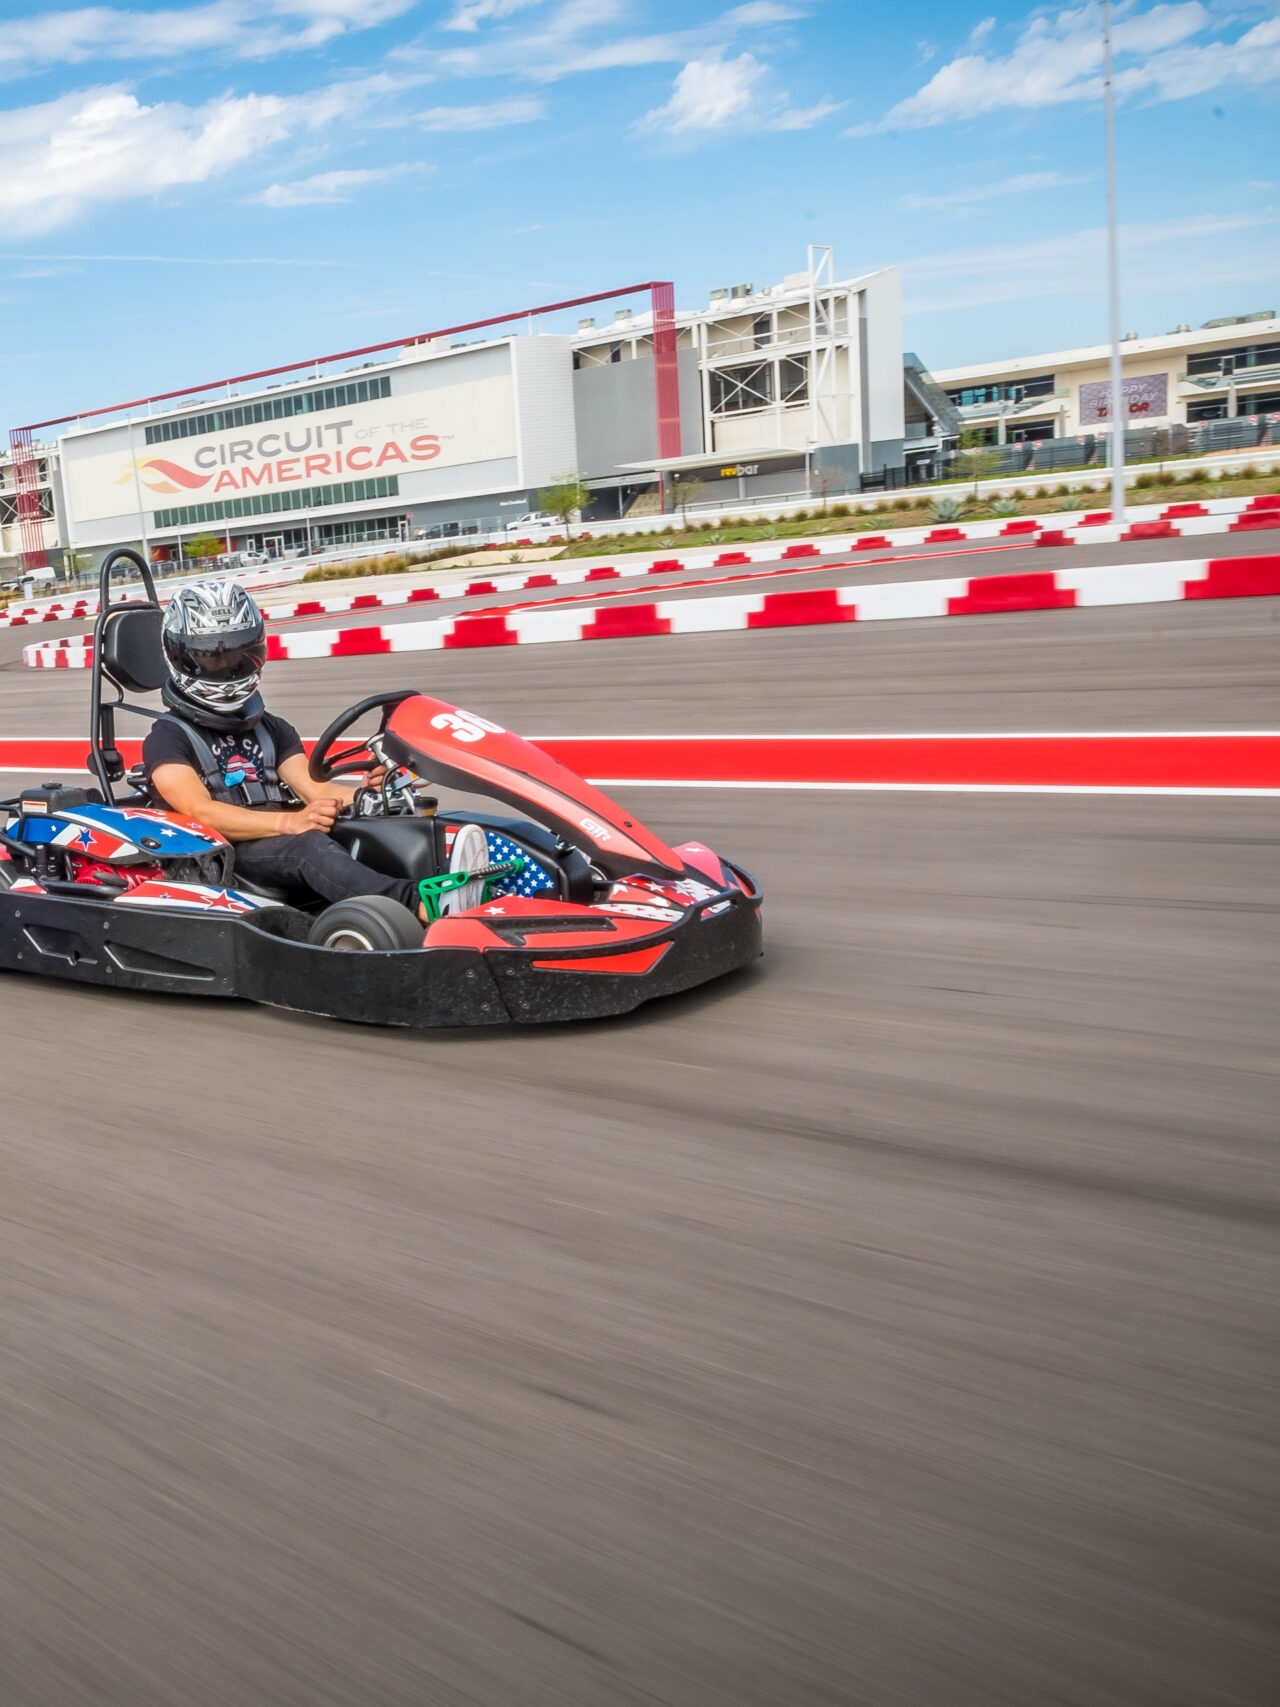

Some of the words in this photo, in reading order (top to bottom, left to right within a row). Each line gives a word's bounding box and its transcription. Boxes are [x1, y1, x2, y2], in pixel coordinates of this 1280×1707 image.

[194, 420, 353, 469] CIRCUIT
[355, 425, 381, 440] OF
[386, 417, 429, 434] THE
[213, 434, 442, 493] AMERICAS
[211, 608, 233, 616] BELL
